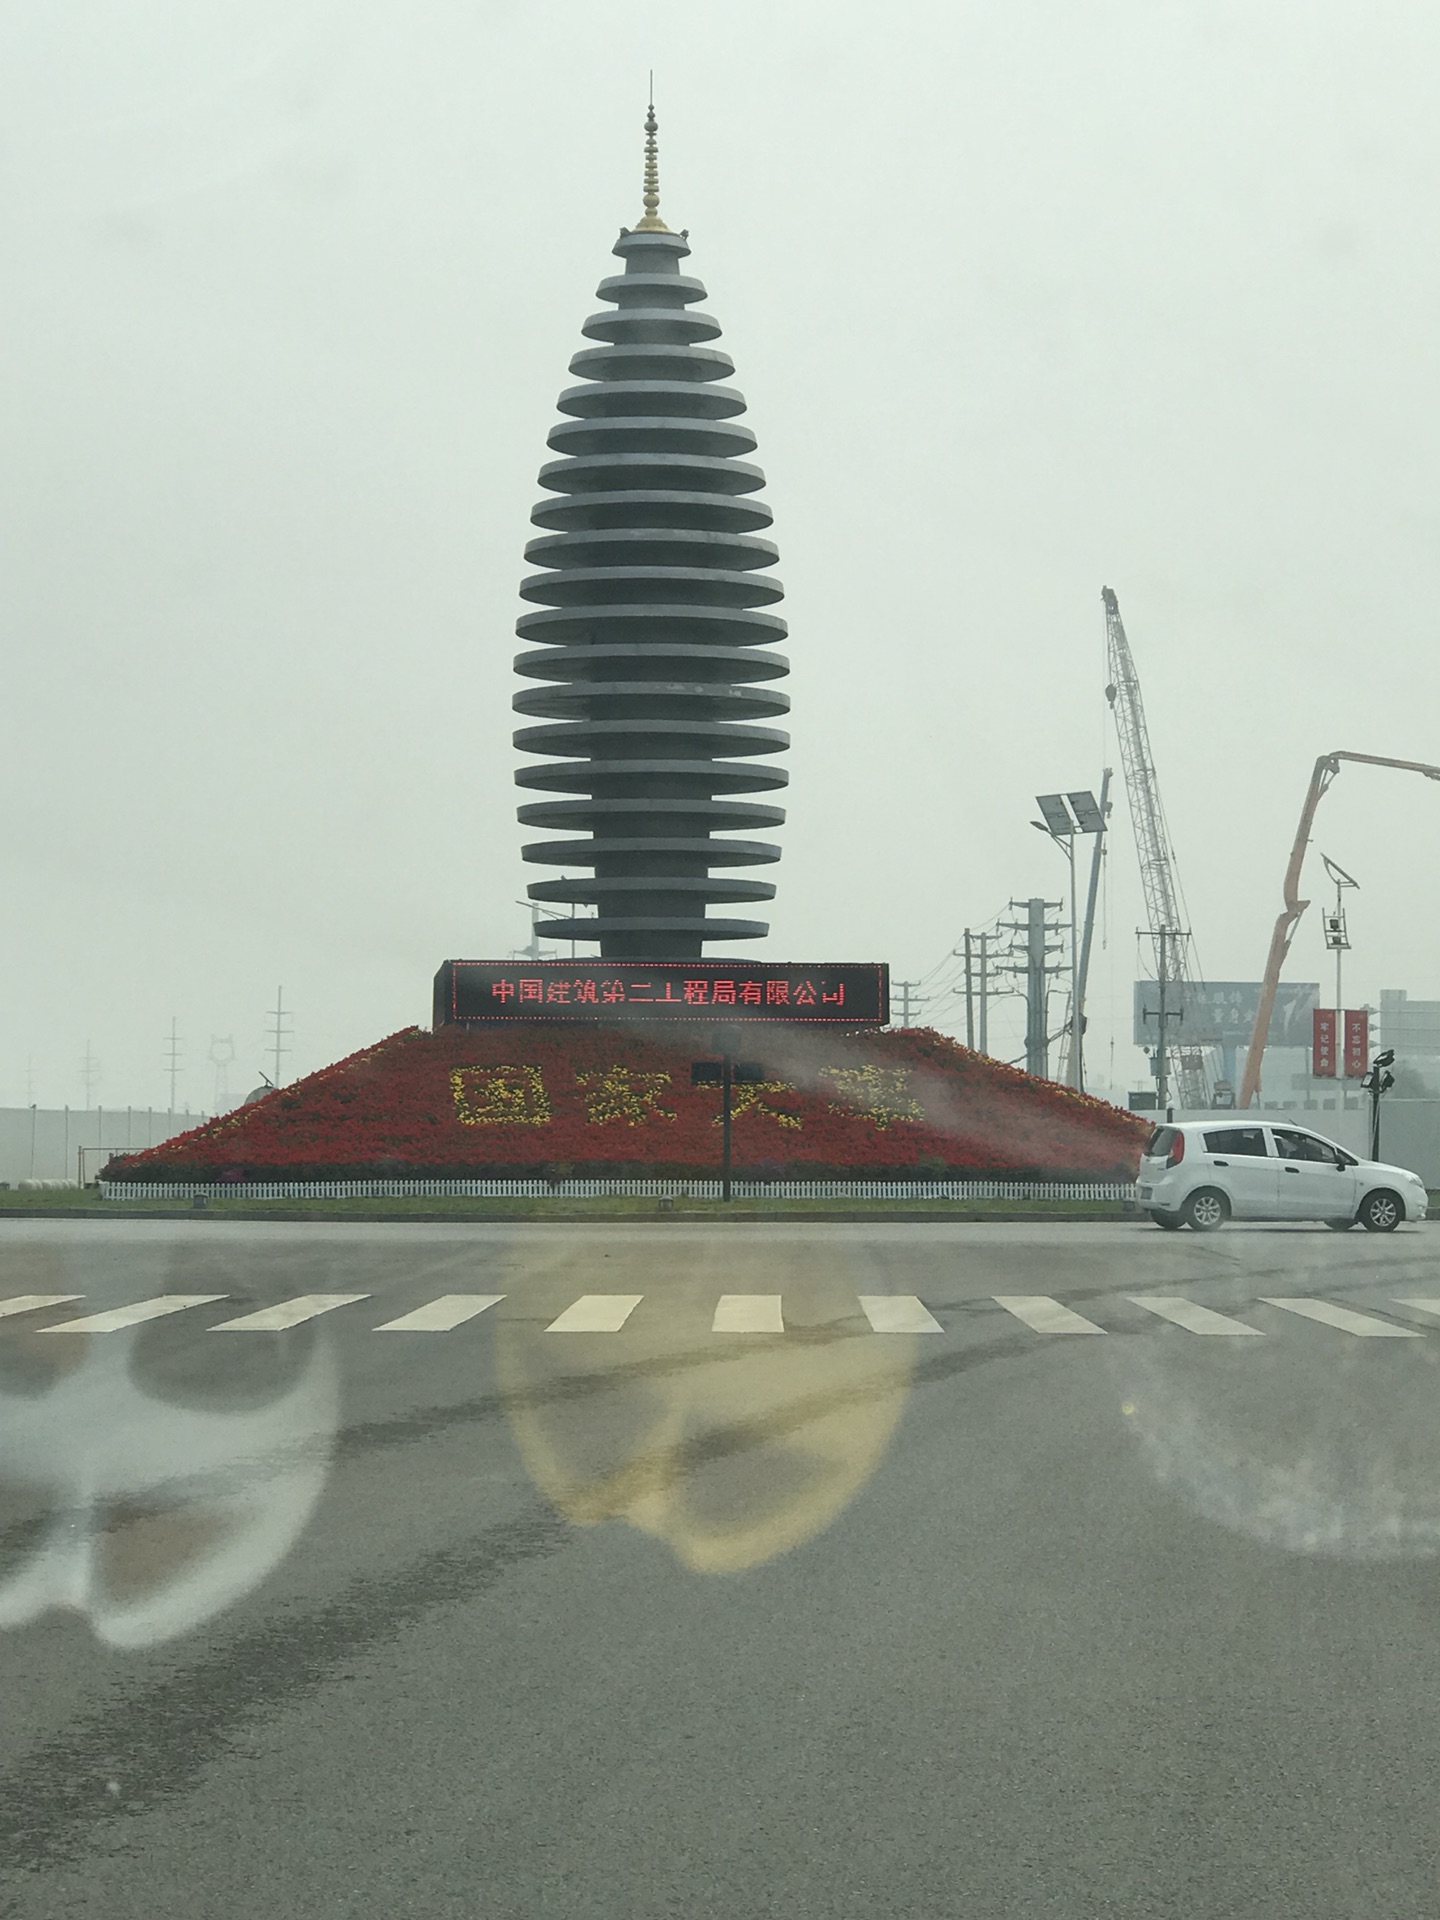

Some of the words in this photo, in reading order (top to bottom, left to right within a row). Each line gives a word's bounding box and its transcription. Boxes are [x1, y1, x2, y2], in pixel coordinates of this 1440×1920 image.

[491, 978, 845, 1006] 中国建筑第二工程局有限公司
[1319, 1022, 1330, 1068] 牢记使命
[1351, 1022, 1361, 1069] 不忘初心
